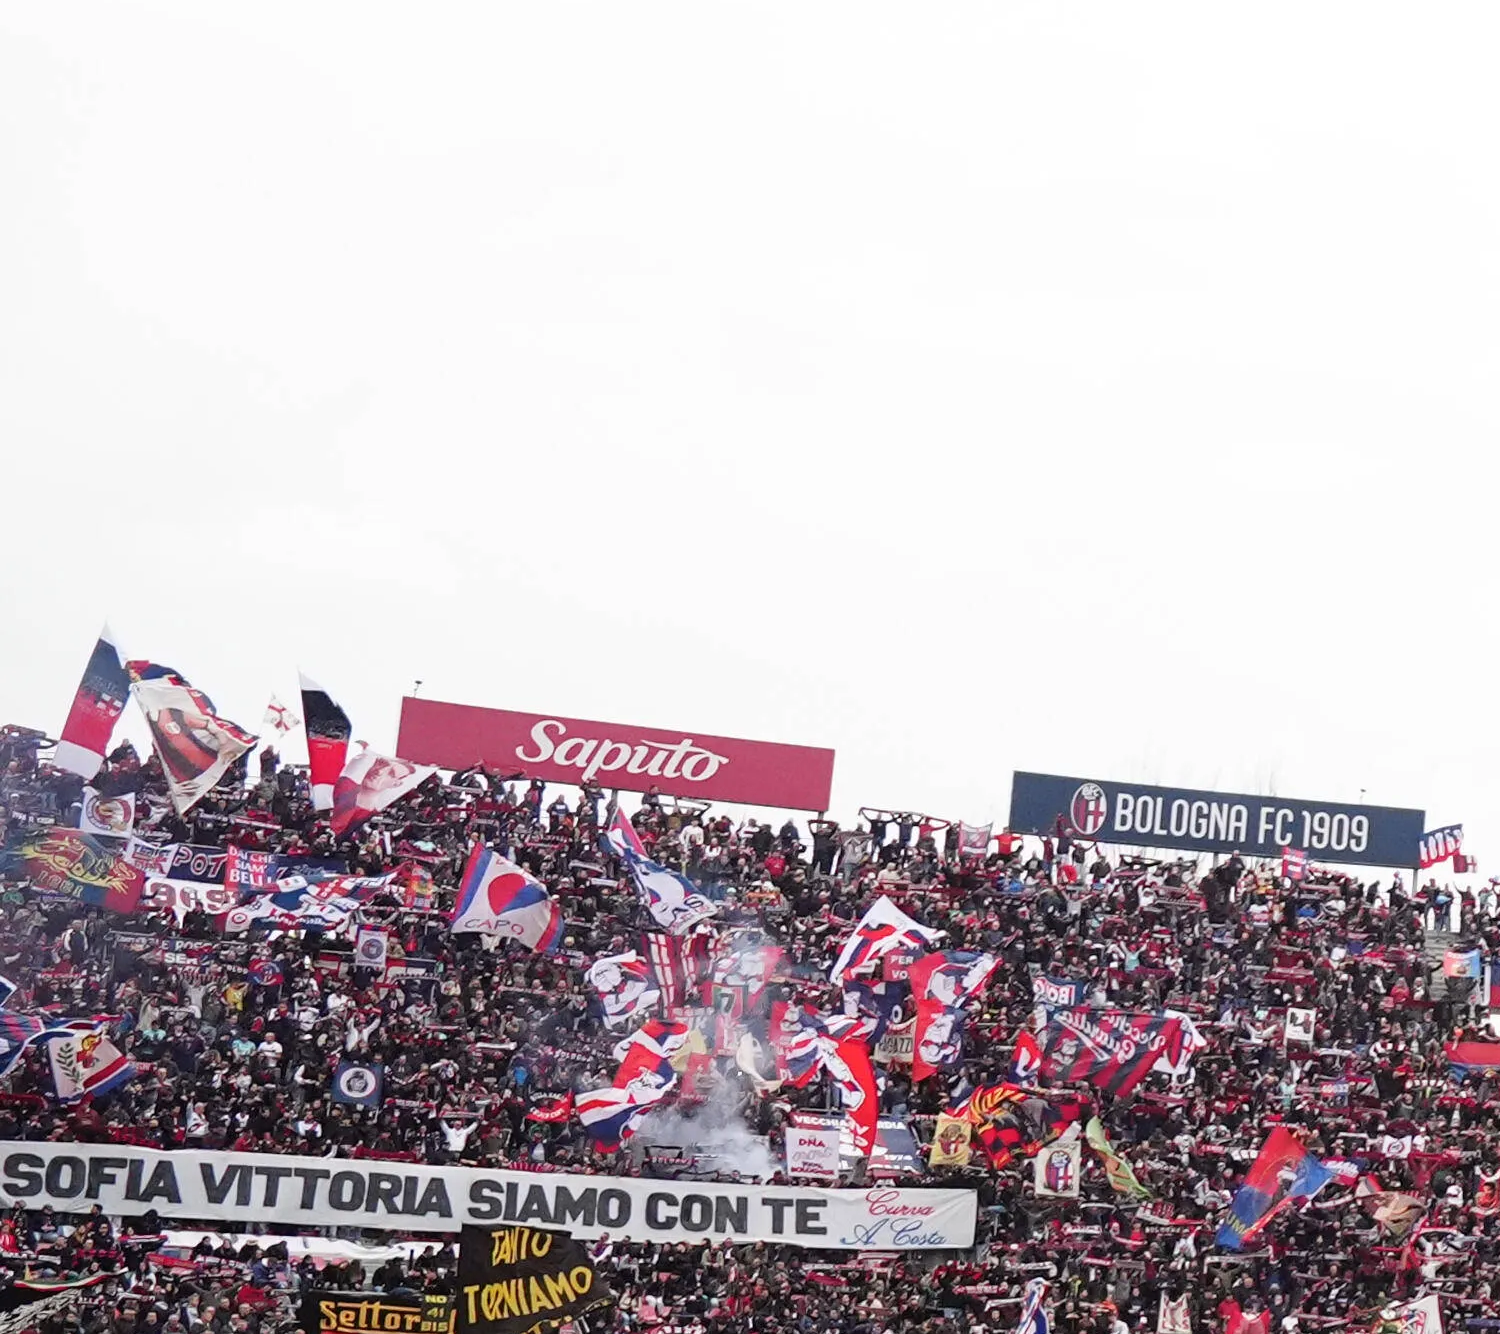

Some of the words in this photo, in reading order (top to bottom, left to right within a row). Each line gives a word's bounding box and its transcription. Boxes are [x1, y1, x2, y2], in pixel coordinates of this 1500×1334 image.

[515, 719, 730, 784] Saputo
[1113, 793, 1248, 844] BOLOGNA
[1258, 807, 1294, 847] FC
[1302, 811, 1369, 853] 1909
[2, 1153, 182, 1205] SOFIA
[200, 1162, 453, 1219] VITTORIA
[468, 1179, 631, 1227] SIAMO
[644, 1192, 747, 1235] CON
[761, 1197, 828, 1236] TE
[865, 1190, 935, 1216] Curva
[890, 1218, 948, 1246] Costa
[425, 1295, 446, 1304] NO
[427, 1307, 444, 1317] 41
[421, 1321, 448, 1332] BIS
